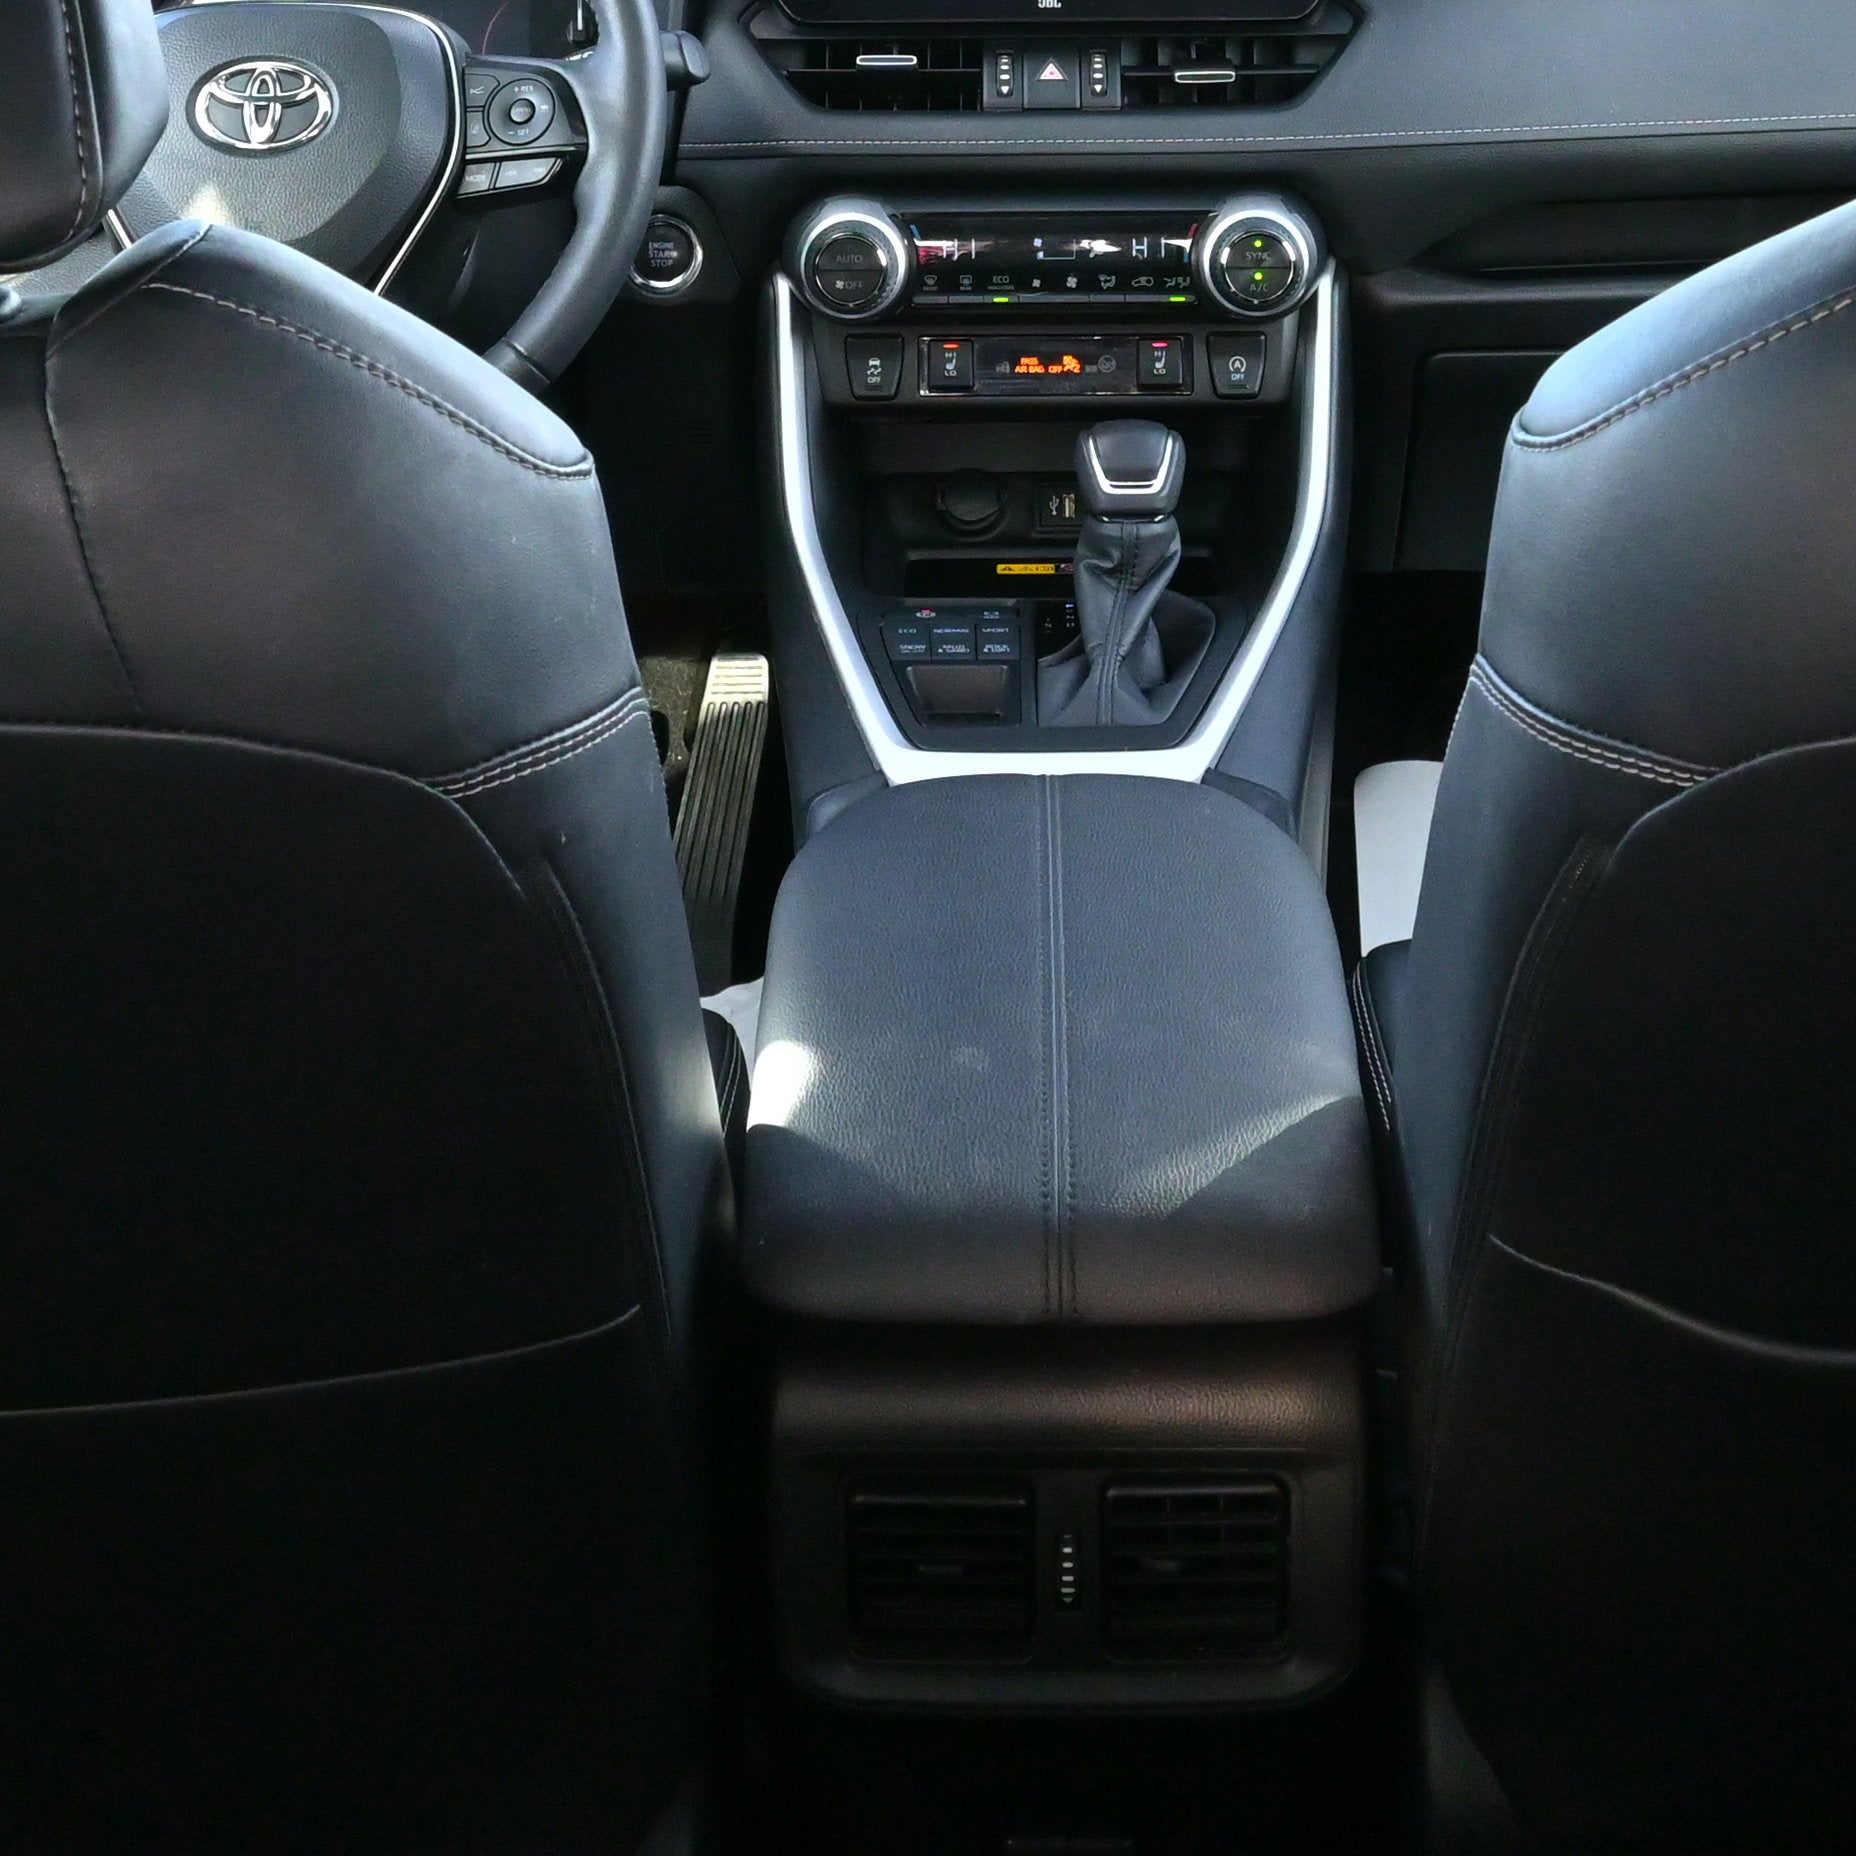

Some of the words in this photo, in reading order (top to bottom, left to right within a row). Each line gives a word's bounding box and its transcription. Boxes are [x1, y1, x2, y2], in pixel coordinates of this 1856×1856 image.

[835, 254, 863, 264] AUTO
[1245, 251, 1271, 261] SYNC
[650, 259, 674, 267] STOP
[992, 275, 1010, 284] ECO
[845, 280, 863, 290] OFF
[1249, 282, 1269, 292] A/C
[867, 376, 882, 384] OFF
[1231, 373, 1245, 381] OFF
